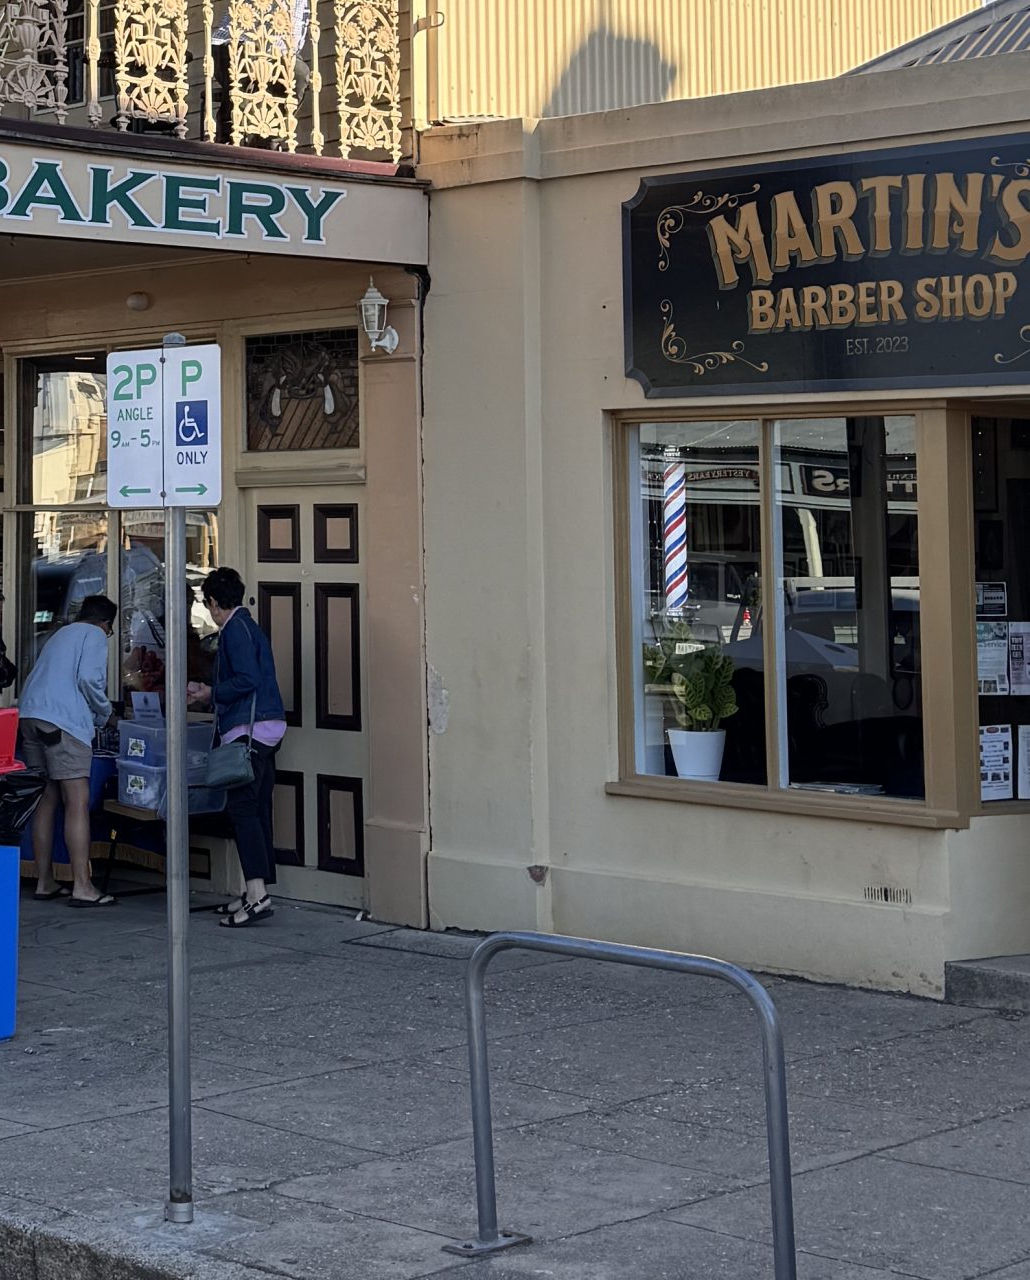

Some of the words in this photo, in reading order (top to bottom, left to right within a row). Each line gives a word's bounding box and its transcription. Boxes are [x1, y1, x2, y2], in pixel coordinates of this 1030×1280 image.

[706, 171, 1030, 290] MARTIN'S
[748, 279, 908, 335] BARBER
[914, 271, 1018, 320] SHOP
[846, 338, 872, 356] EST.
[876, 335, 909, 354] 2023
[112, 363, 157, 401] 2P
[181, 360, 203, 397] P
[117, 407, 154, 421] ANGLE
[176, 451, 208, 465] ONLY
